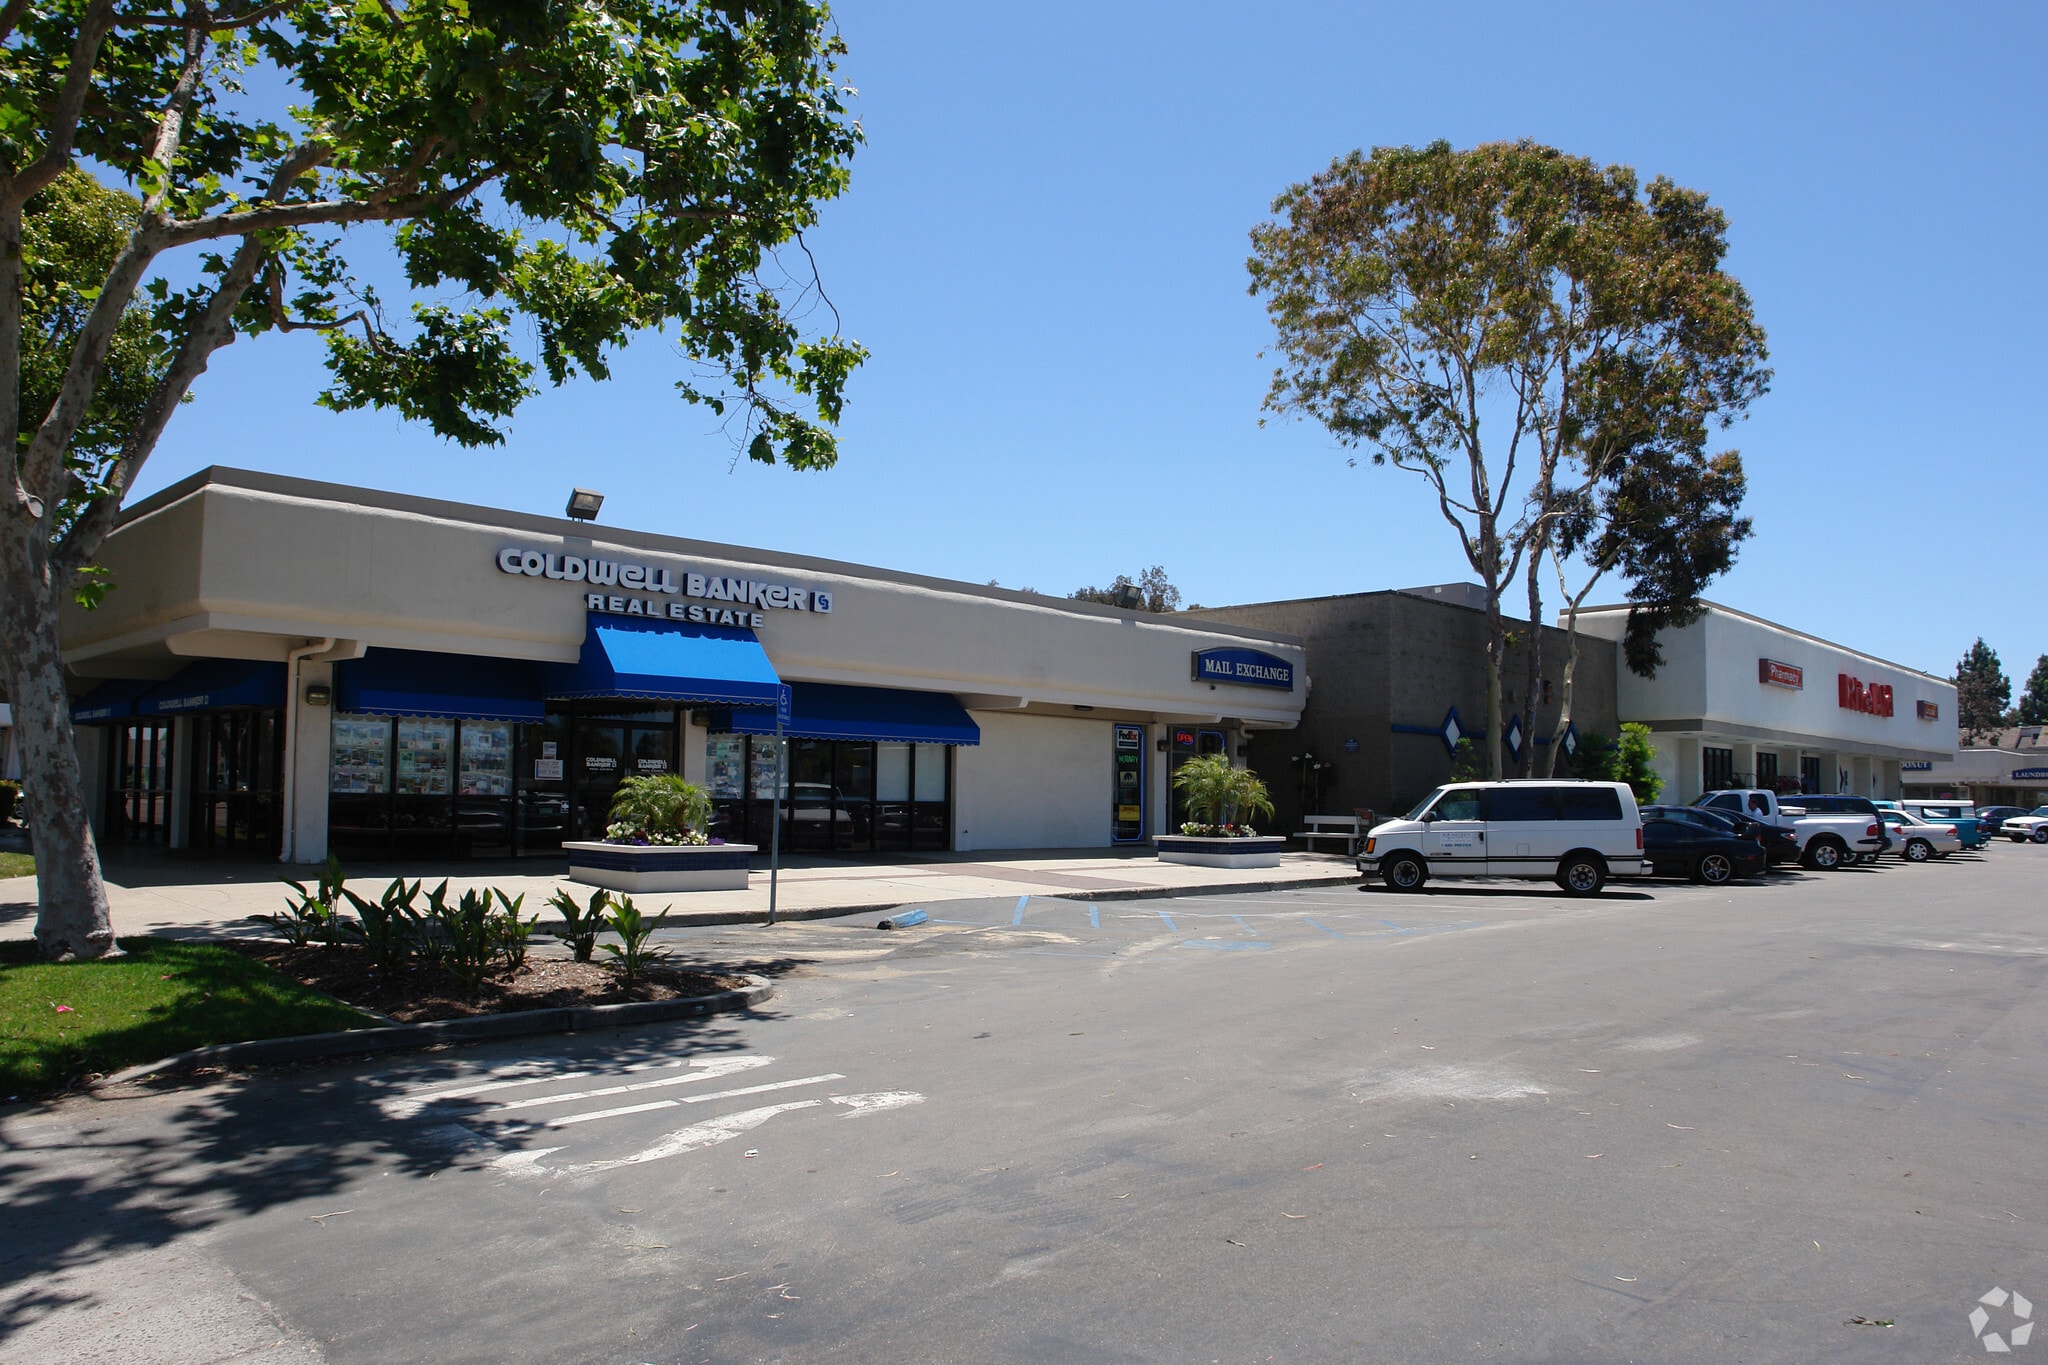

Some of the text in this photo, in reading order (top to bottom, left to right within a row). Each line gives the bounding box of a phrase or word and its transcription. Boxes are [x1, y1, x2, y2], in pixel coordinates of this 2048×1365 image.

[498, 548, 679, 594] COLDWELL
[686, 573, 808, 611] BANKER
[586, 594, 764, 628] REAL ESTATE
[1205, 659, 1289, 681] MAIL EXCHANGE
[1770, 664, 1800, 686] Pharmacy
[1119, 730, 1137, 740] FedEx
